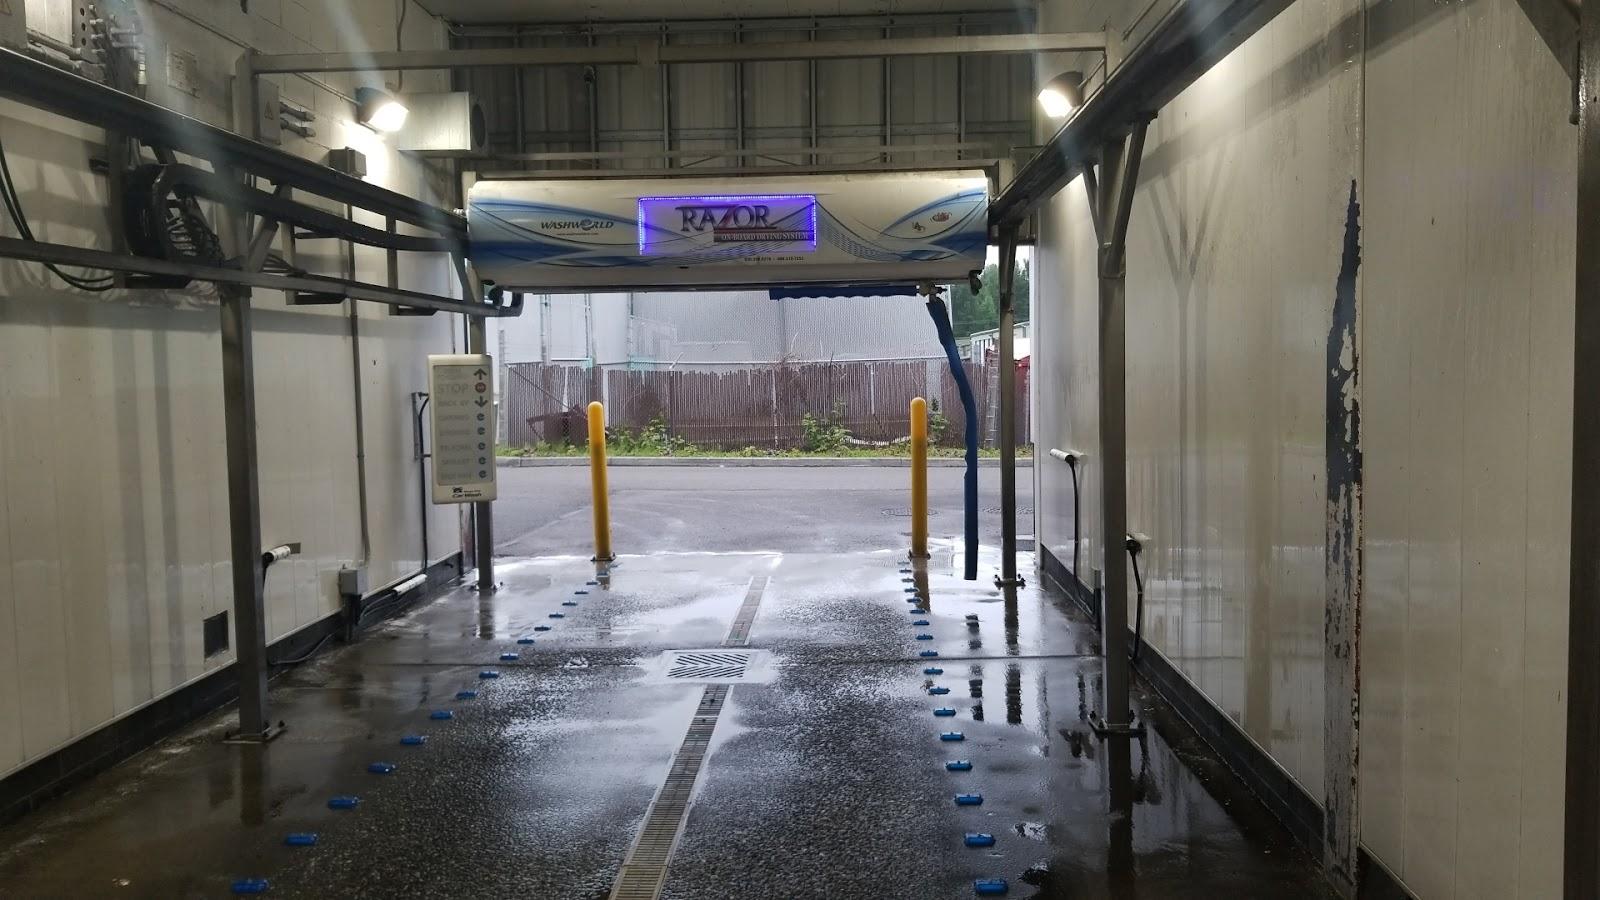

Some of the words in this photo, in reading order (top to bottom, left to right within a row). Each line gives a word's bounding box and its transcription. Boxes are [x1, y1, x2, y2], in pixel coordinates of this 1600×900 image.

[675, 205, 772, 231] RAZOR
[722, 233, 756, 241] ON-BOARD
[783, 232, 808, 240] SYSTEM
[438, 384, 470, 393] STOP
